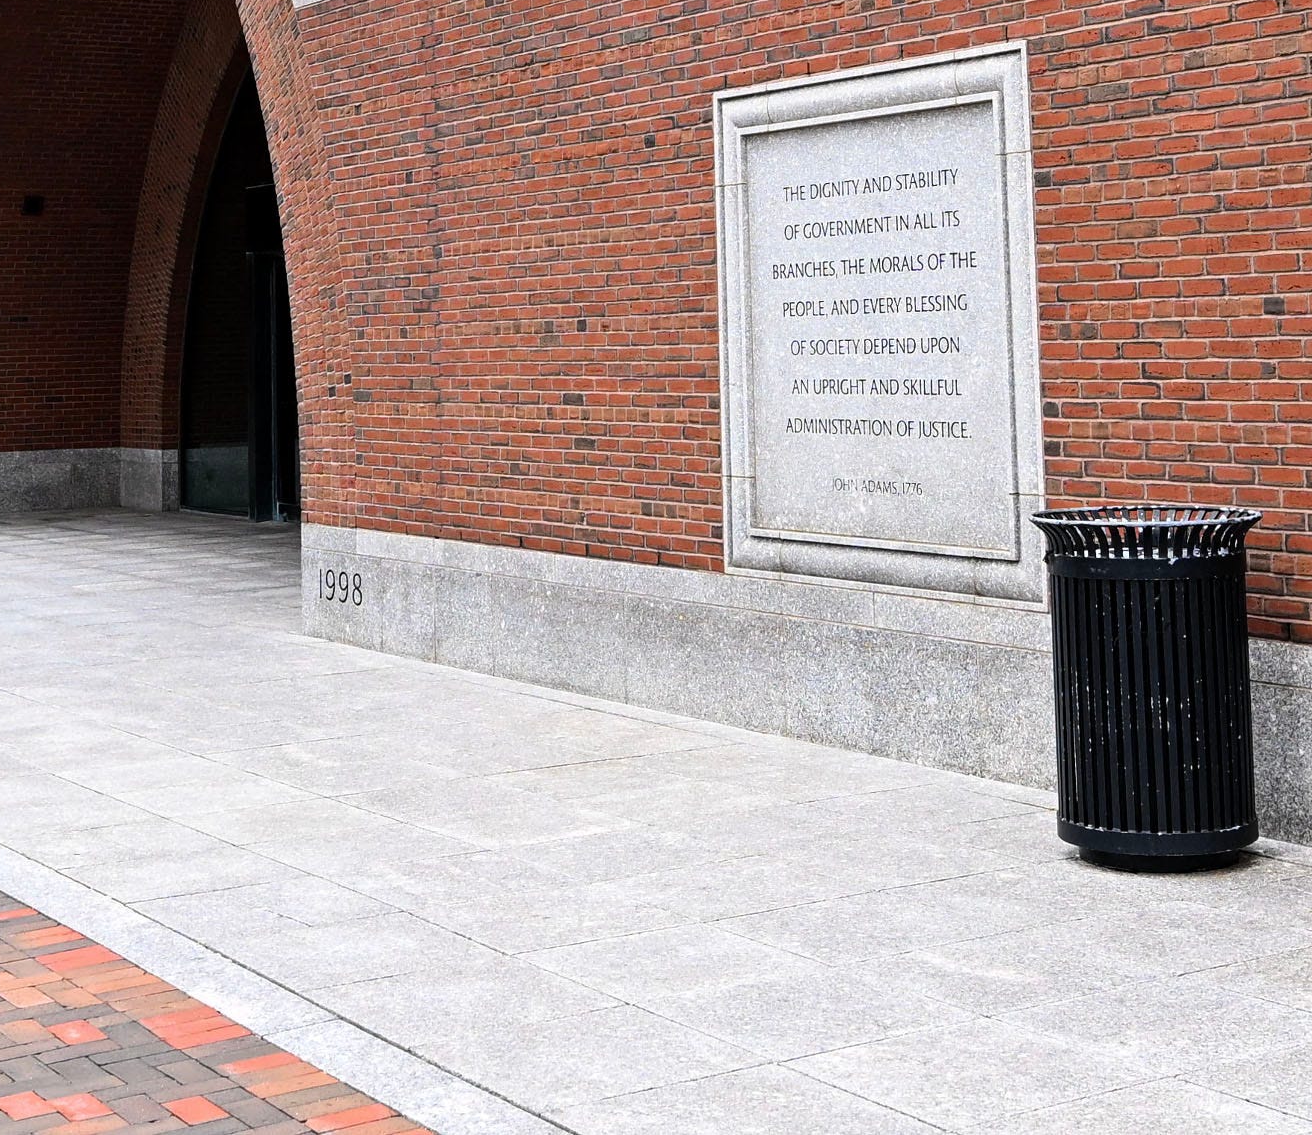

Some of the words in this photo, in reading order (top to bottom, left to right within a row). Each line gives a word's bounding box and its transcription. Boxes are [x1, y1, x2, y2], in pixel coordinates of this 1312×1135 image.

[783, 185, 806, 202] THE
[810, 179, 860, 200] DIGNITY
[863, 175, 892, 194] AND
[895, 168, 959, 191] STABILITY
[784, 224, 800, 241] OF
[803, 216, 892, 239] GOVERNMENT
[895, 215, 909, 231] IN
[914, 213, 937, 230] ALL
[941, 210, 961, 228] ITS
[772, 260, 838, 280] BRANCHES,
[840, 258, 866, 276] THE
[869, 254, 924, 275] MORALS
[927, 253, 946, 271] OF
[949, 251, 978, 269] THE
[782, 300, 828, 317] PEOPLE,
[831, 298, 859, 316] AND
[863, 297, 902, 315] EVERY
[905, 293, 968, 313] BLESSING
[790, 340, 807, 356] OF
[809, 339, 861, 356] SOCIETY
[863, 337, 916, 355] DEPEND
[920, 336, 960, 354] UPON
[791, 379, 809, 395] AN
[813, 378, 867, 395] UPRIGHT
[870, 378, 900, 396] AND
[903, 378, 963, 396] SKILLFUL
[785, 417, 893, 437] ADMINISTRATION
[896, 420, 915, 437] OF
[918, 421, 972, 439] JUSTICE.
[832, 477, 858, 492] JOHN
[861, 480, 900, 497] ADAMS,
[902, 482, 923, 496] 1776
[319, 568, 363, 606] 1998
